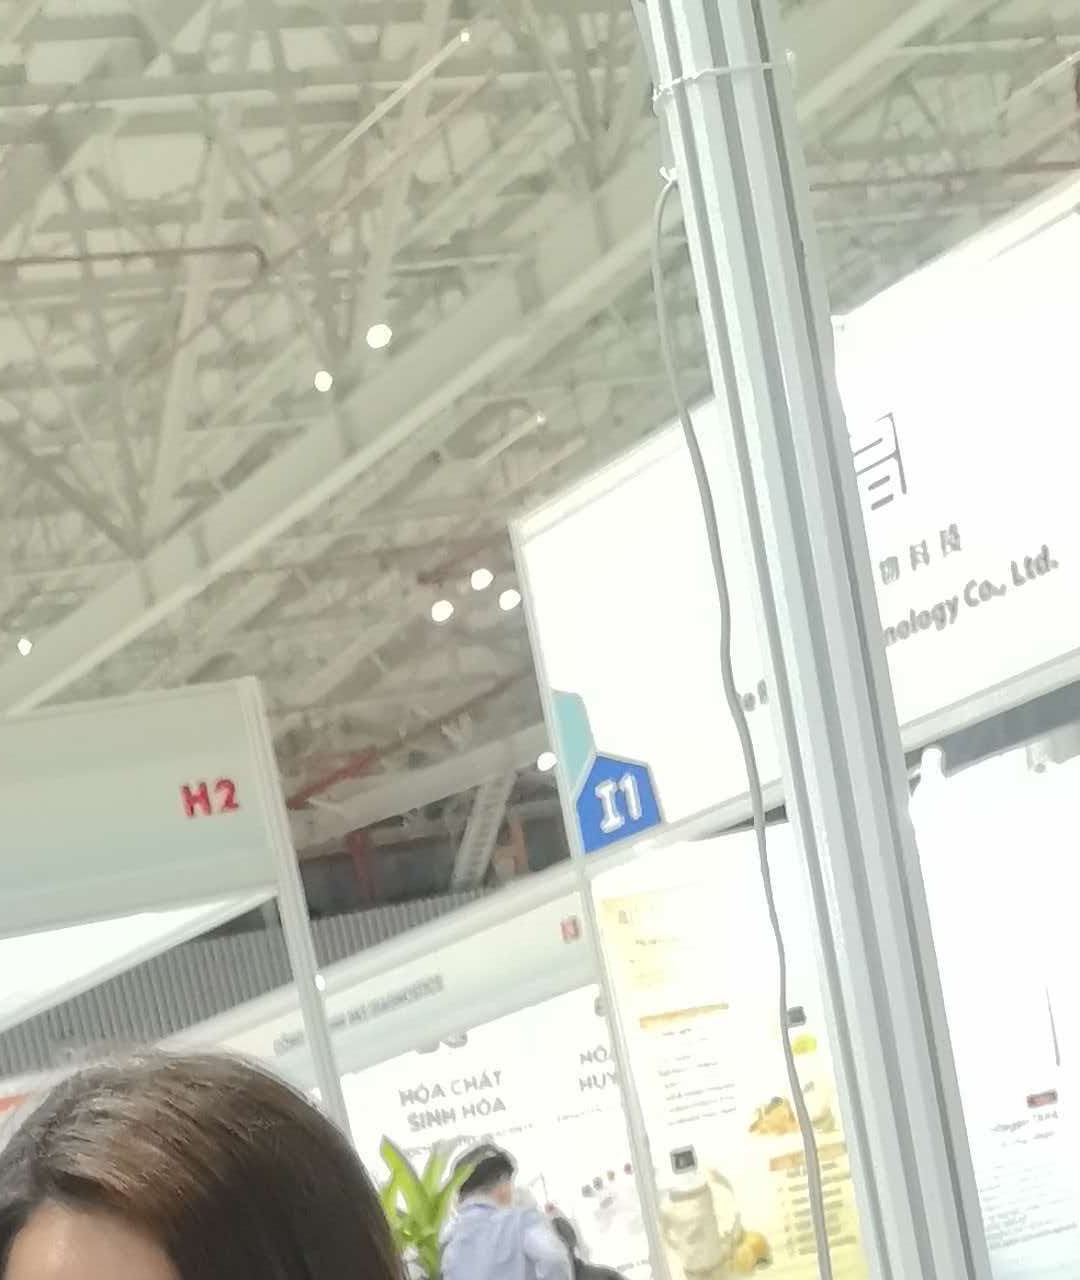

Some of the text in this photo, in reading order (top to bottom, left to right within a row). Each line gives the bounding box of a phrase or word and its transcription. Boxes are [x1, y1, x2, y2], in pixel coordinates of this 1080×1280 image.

[179, 778, 241, 818] H2
[594, 773, 645, 833] I1
[407, 1107, 457, 1133] SINH
